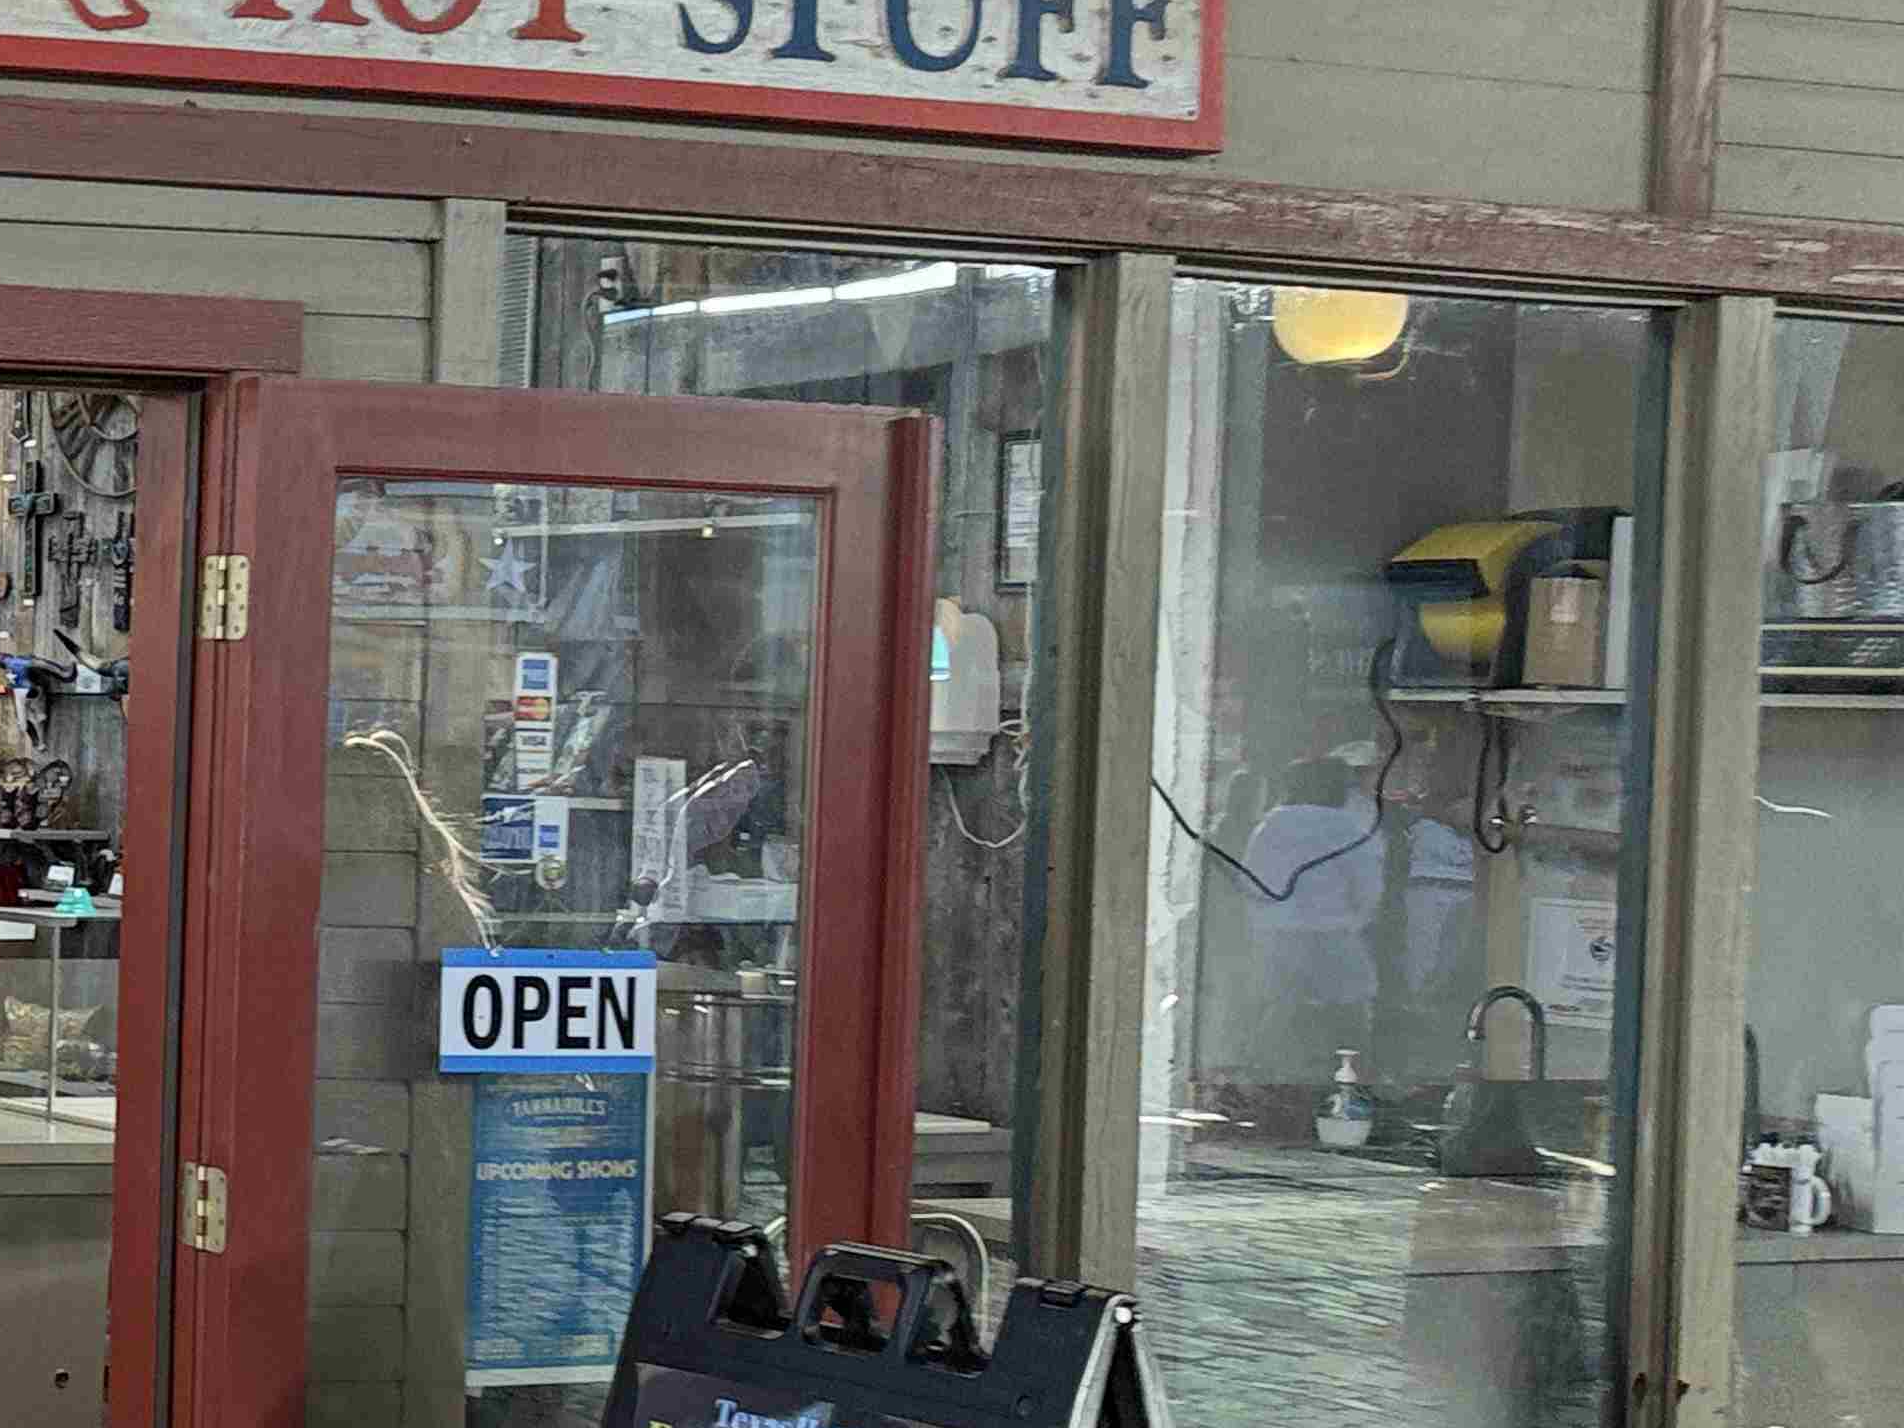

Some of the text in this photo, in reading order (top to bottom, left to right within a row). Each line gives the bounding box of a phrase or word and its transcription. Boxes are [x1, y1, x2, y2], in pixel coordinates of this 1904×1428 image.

[462, 974, 636, 1050] OPEN
[476, 1158, 638, 1180] UPCOMING SHOWS
